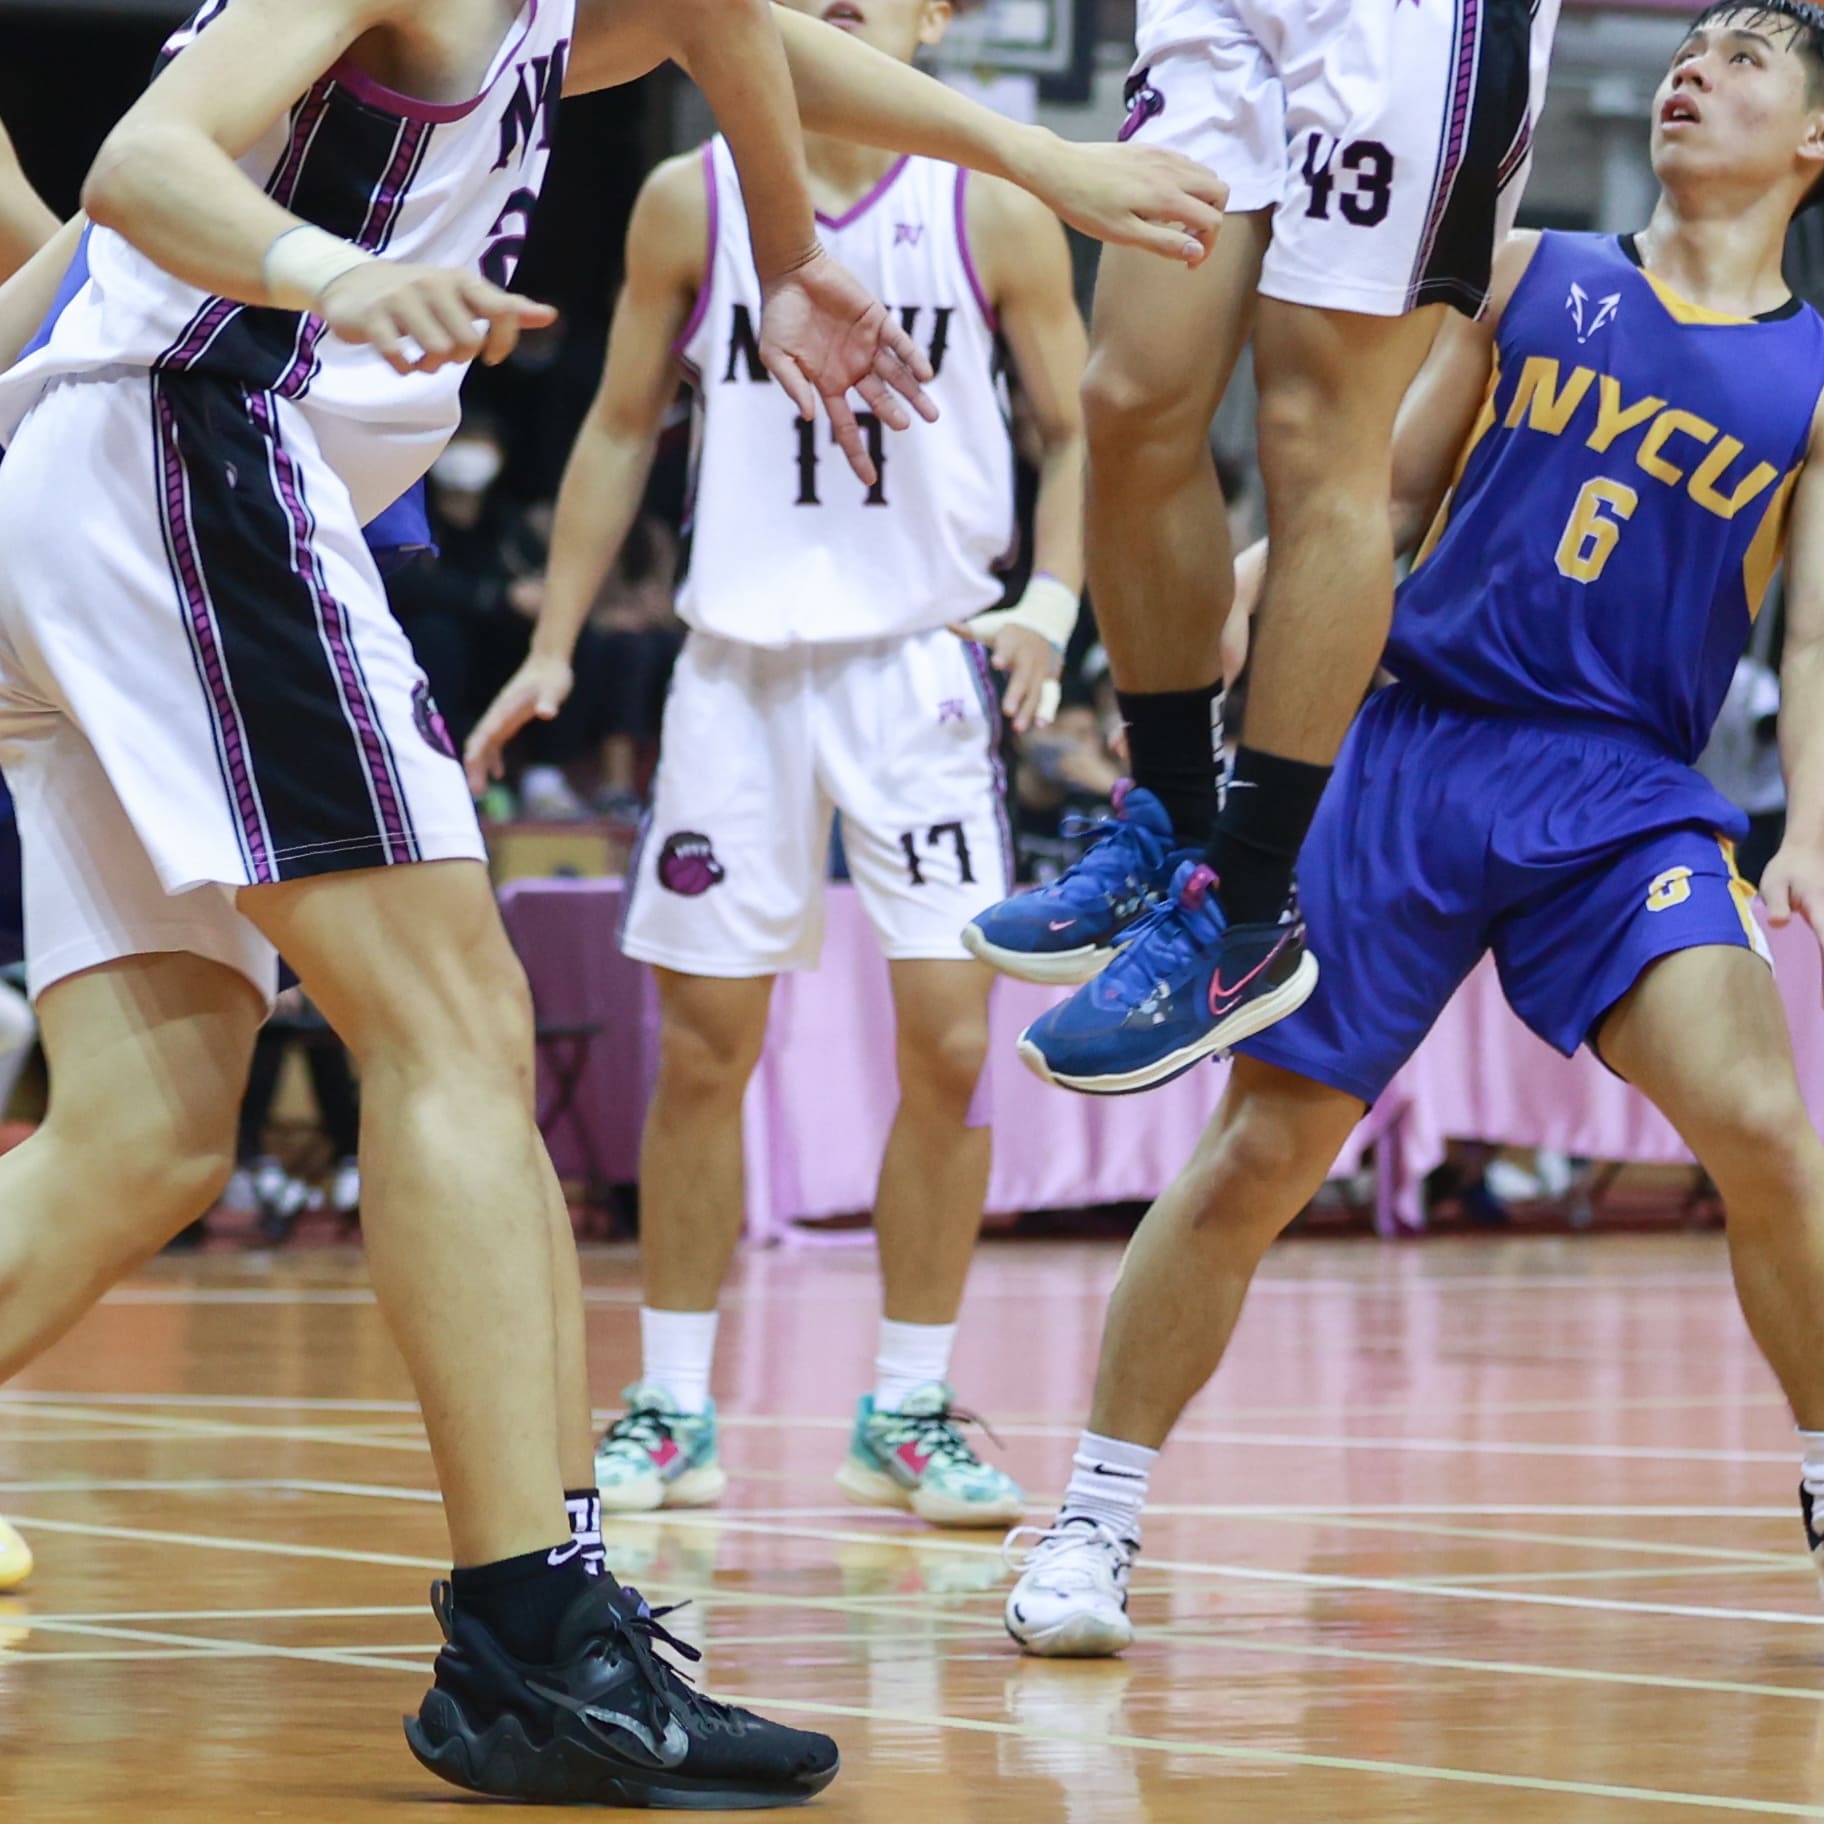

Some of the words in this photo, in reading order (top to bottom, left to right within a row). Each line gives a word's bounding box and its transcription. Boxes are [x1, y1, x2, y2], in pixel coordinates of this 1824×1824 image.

[1302, 132, 1395, 229] 43
[722, 303, 956, 384] NU
[794, 411, 889, 506] 17
[1504, 356, 1779, 520] NYCU
[1555, 476, 1639, 585] 6
[899, 821, 977, 886] 17
